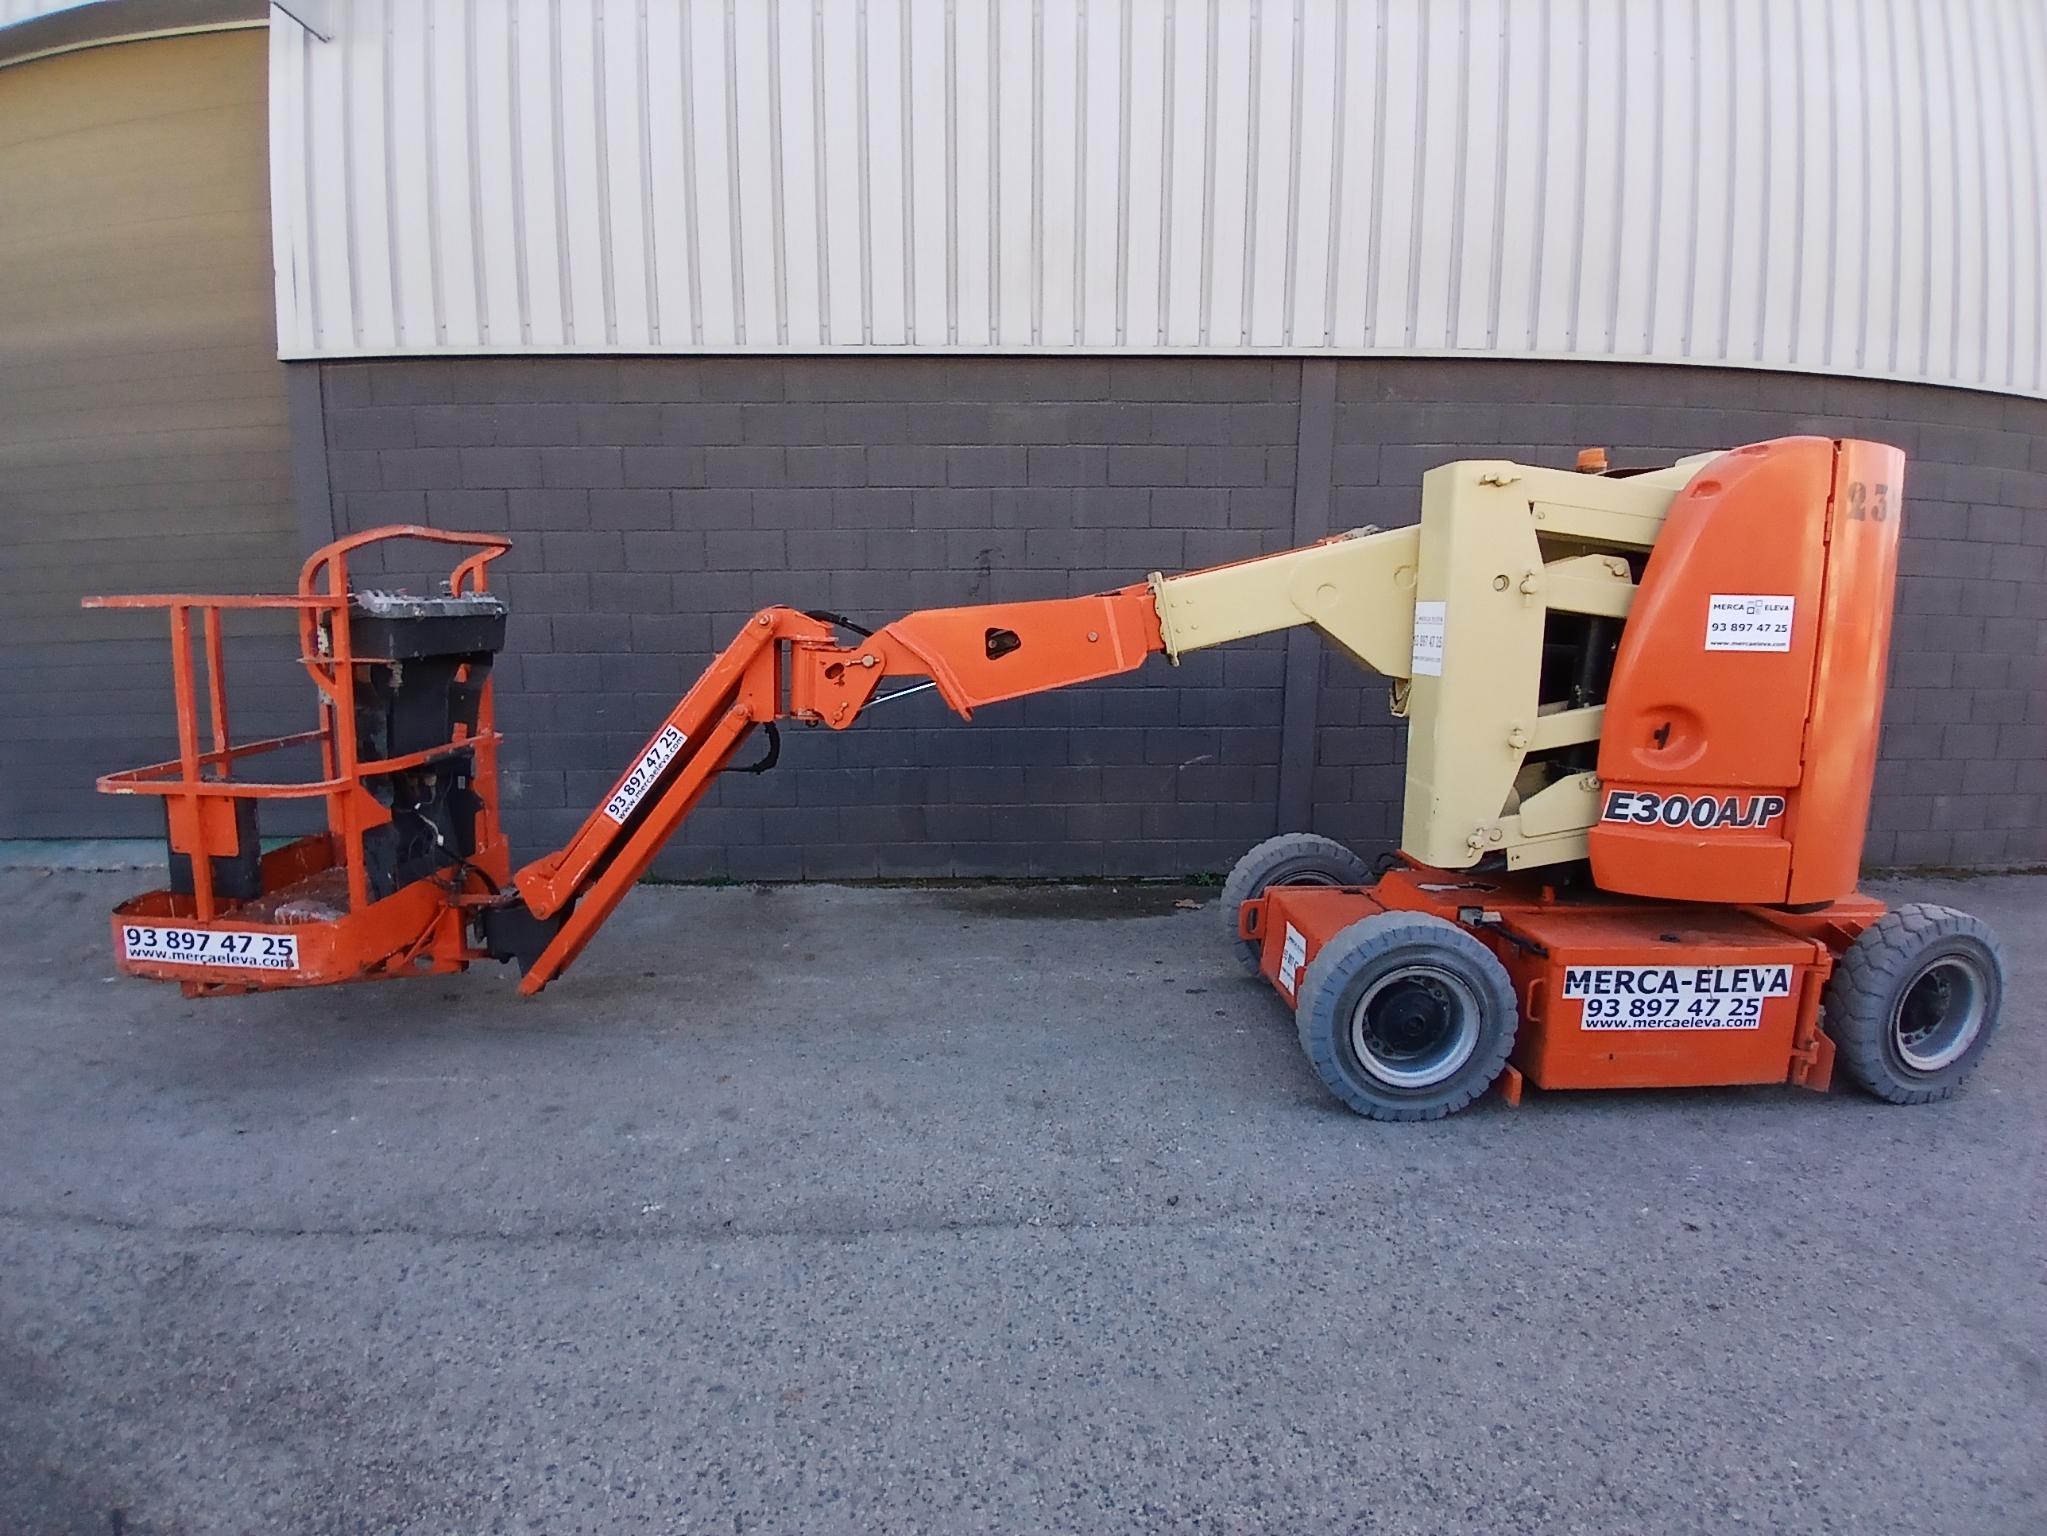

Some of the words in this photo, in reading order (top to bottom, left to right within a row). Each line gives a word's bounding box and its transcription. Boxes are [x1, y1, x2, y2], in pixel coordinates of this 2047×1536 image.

[1847, 481, 1888, 522] 23
[1711, 622, 1727, 632] 93
[1730, 623, 1753, 632] 897
[1756, 623, 1771, 632] 47
[1774, 624, 1788, 633] 25
[608, 795, 626, 816] 93
[623, 767, 646, 796] 897
[646, 747, 661, 768] 47
[659, 728, 678, 749] 25
[1602, 790, 1785, 829] E300AJP
[126, 928, 158, 947] 93
[166, 930, 210, 952] 897
[220, 935, 252, 954] 47
[262, 937, 294, 957] 25
[129, 947, 295, 969] www.mercaeleva.com
[1564, 968, 1789, 995] MERCA-ELEVA
[1587, 998, 1620, 1018] 93
[1628, 998, 1678, 1018] 897
[1687, 998, 1721, 1017] 47
[1728, 998, 1760, 1017] 25
[1585, 1016, 1757, 1029] www.mercaeleva.com
